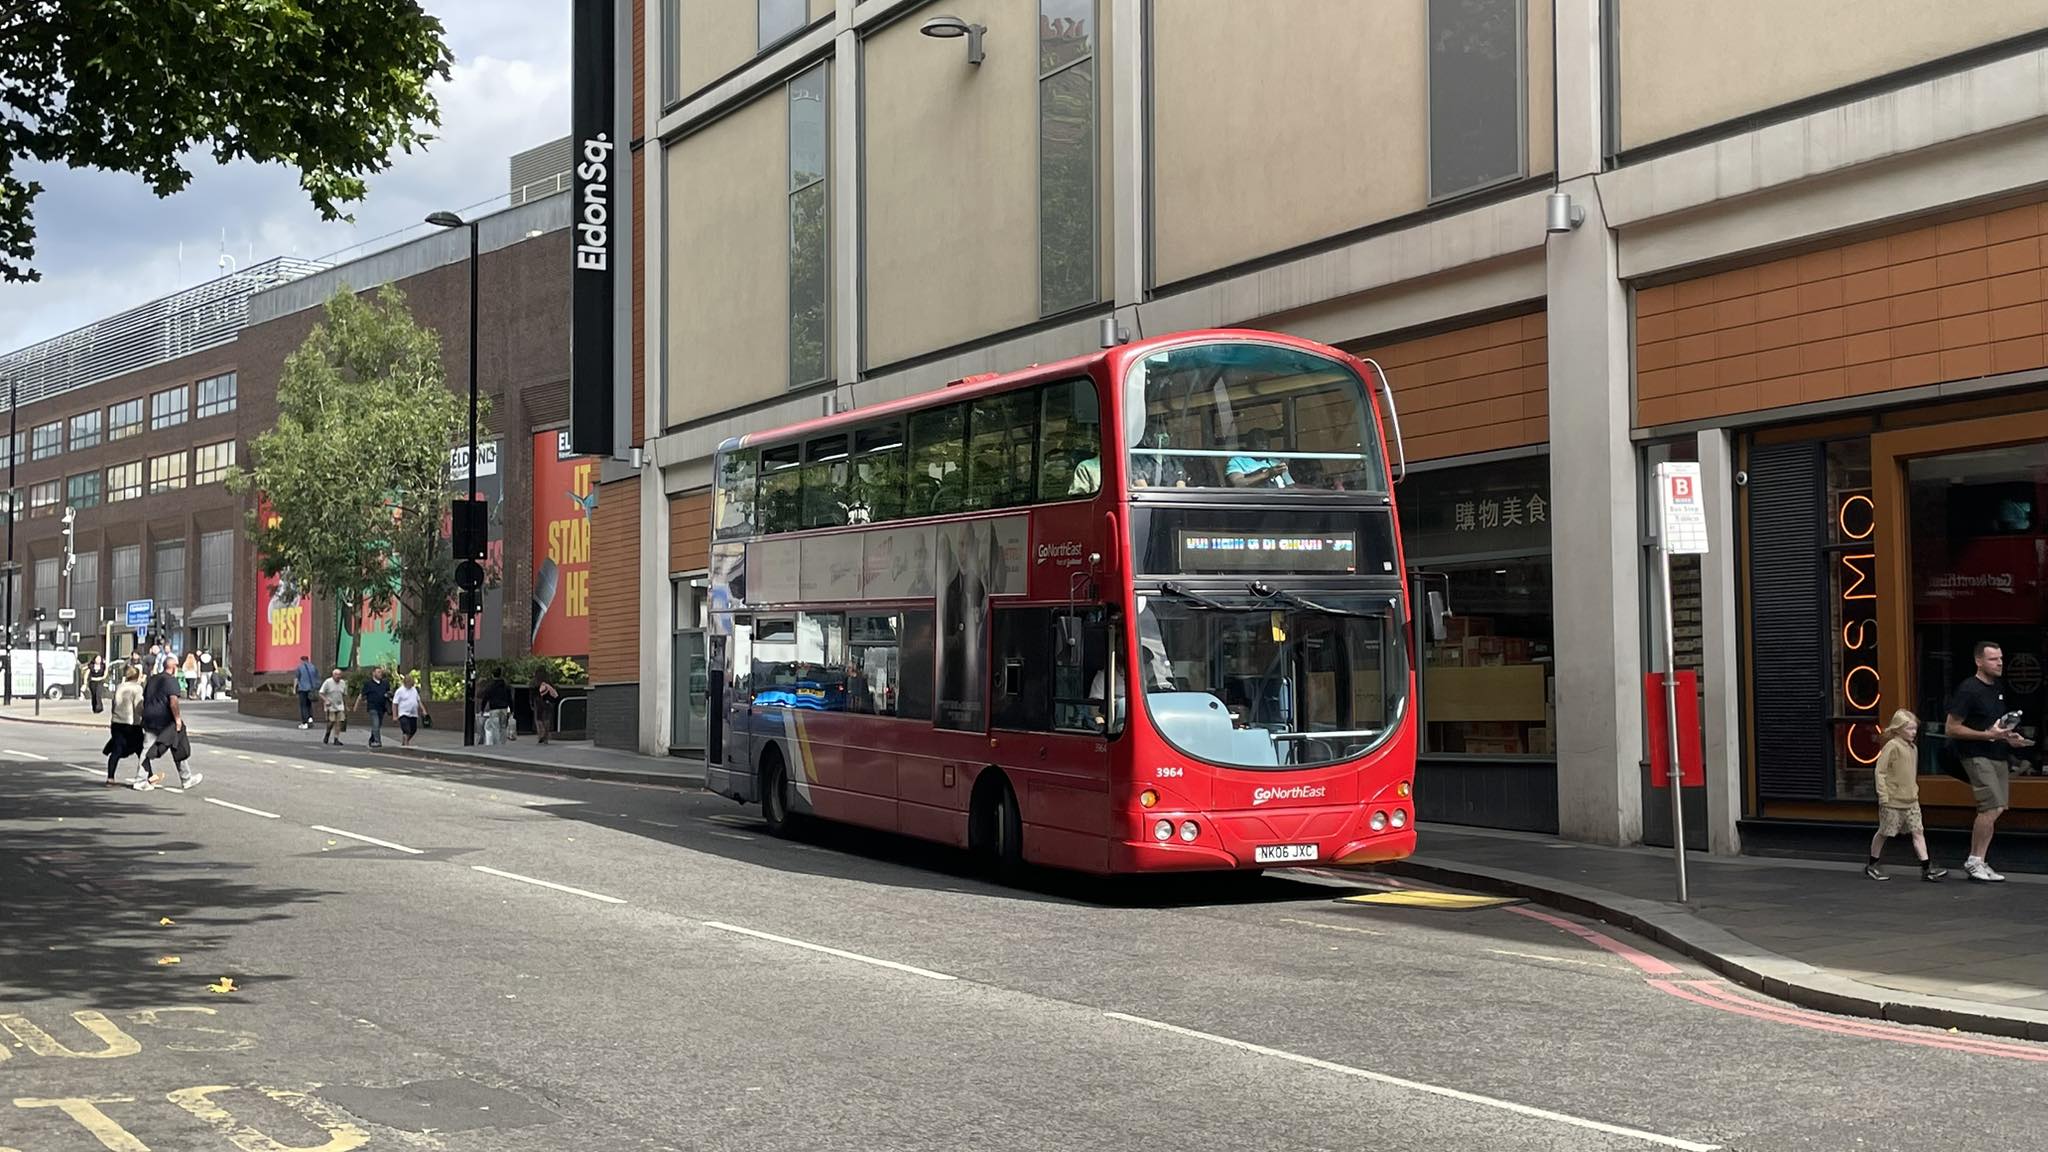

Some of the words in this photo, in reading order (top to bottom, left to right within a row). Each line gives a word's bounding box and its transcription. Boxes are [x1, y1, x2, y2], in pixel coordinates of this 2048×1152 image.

[578, 132, 613, 270] EldonSq.
[451, 446, 485, 469] ELDN
[1455, 493, 1547, 531] 購物美食
[271, 606, 303, 646] BEST
[1841, 495, 1882, 764] COSMO
[1156, 767, 1184, 778] 3964
[1253, 785, 1326, 801] GoNorthEast
[1261, 846, 1289, 859] NK06
[1292, 845, 1313, 858] JXC
[0, 1006, 256, 1060] US
